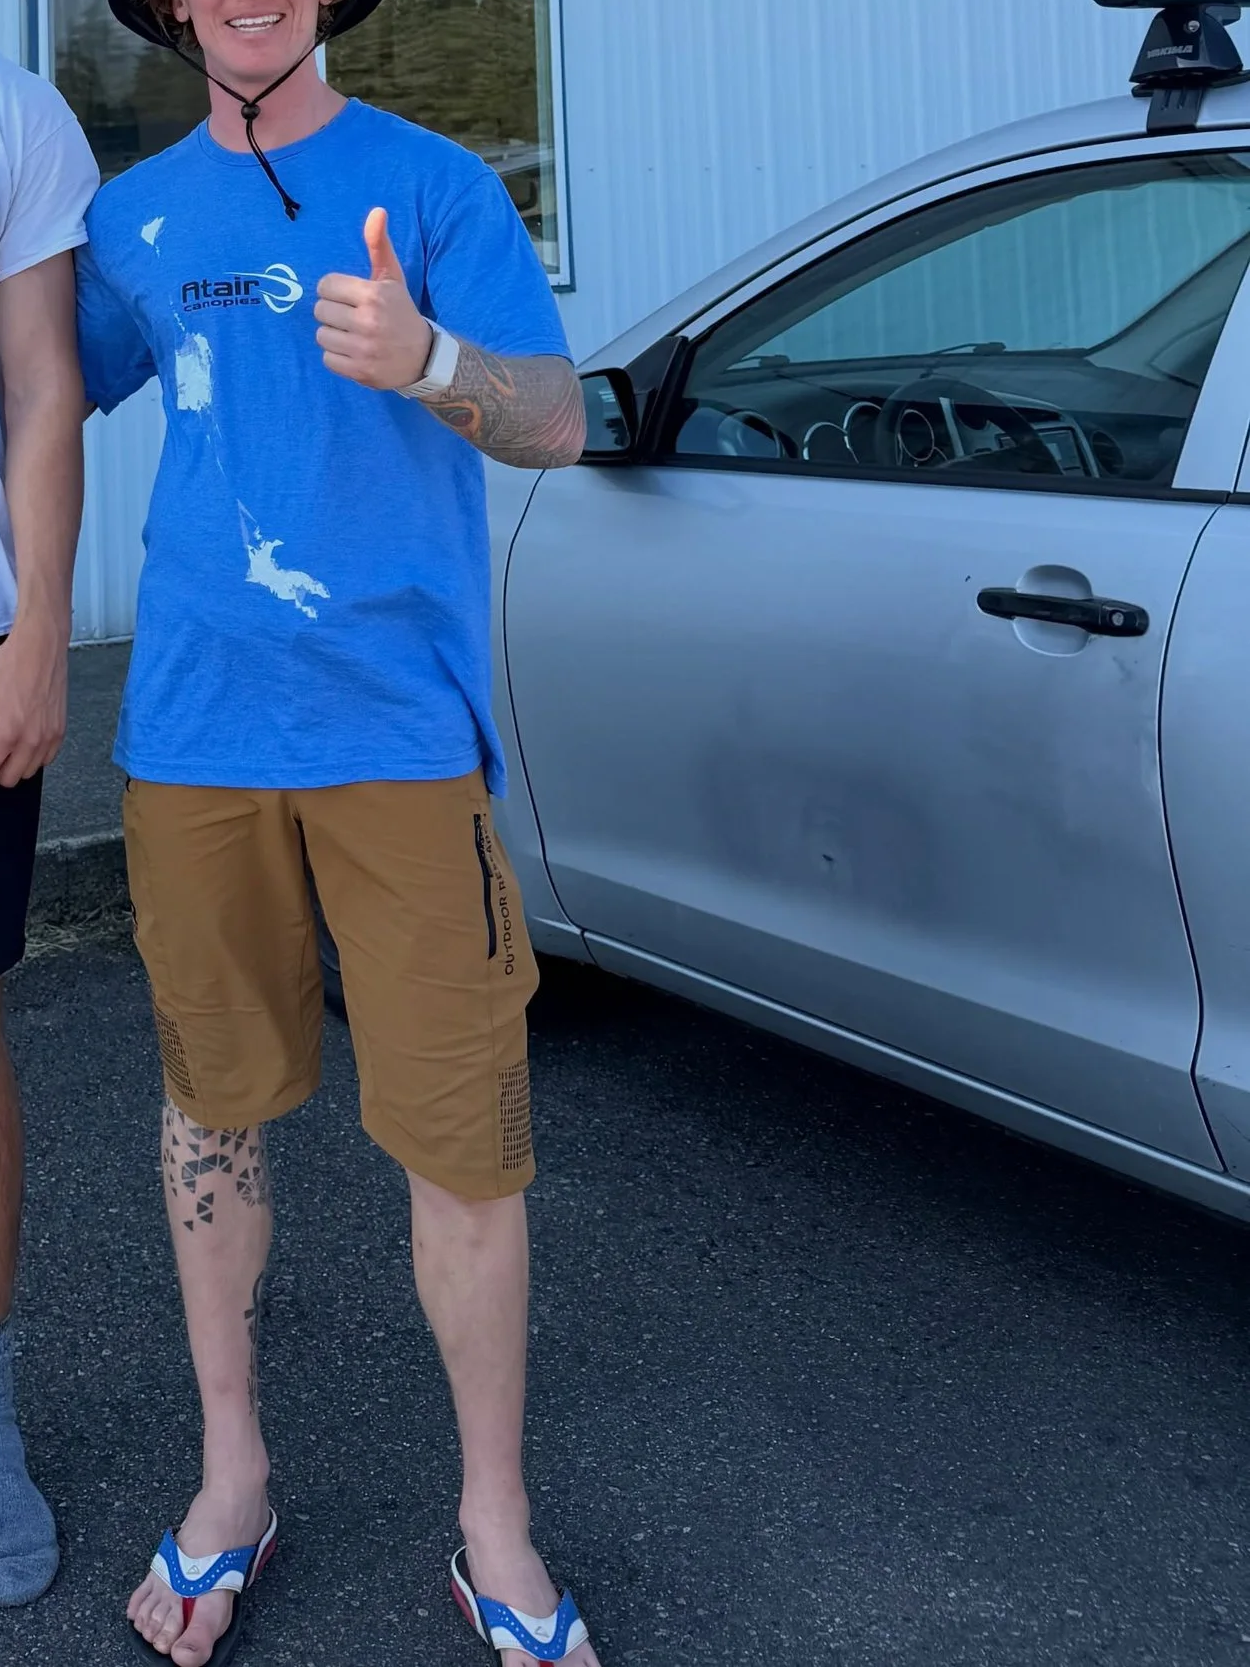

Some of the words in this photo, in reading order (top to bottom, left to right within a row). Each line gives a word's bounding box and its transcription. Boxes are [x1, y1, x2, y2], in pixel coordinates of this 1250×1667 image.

[182, 276, 260, 304] Atair
[184, 297, 261, 312] canopies
[499, 896, 515, 975] OUTDOOR
